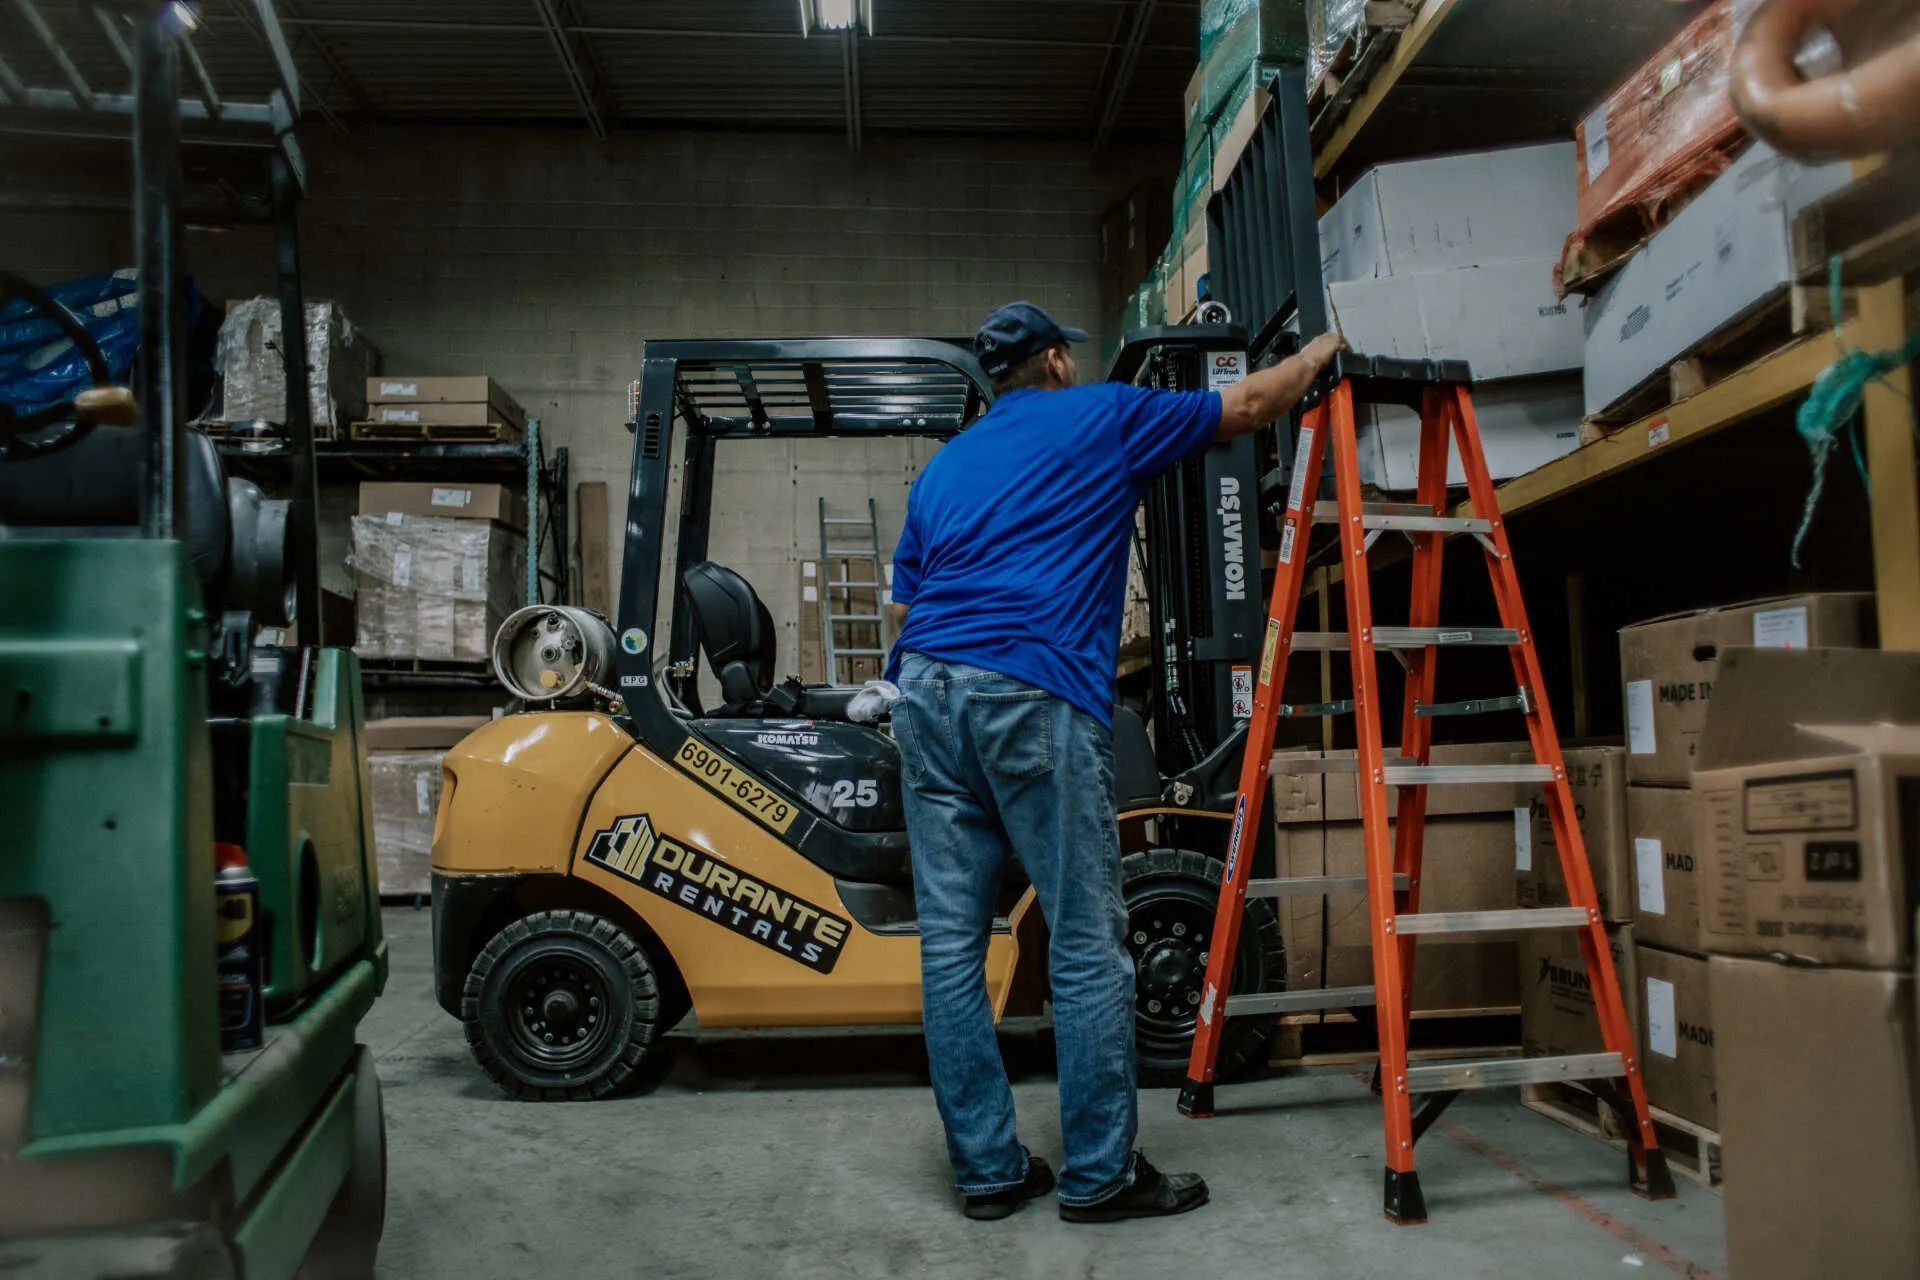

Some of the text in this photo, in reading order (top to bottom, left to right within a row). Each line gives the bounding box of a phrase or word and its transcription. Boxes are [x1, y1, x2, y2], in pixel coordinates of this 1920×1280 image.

[1216, 477, 1245, 600] KOMATSU
[623, 676, 645, 684] LPG
[1659, 682, 1696, 702] MADE
[757, 733, 818, 746] KOMATSU
[680, 742, 788, 823] 6901-6279
[832, 779, 878, 807] 25
[1666, 852, 1696, 873] MAD
[652, 840, 847, 948] DURANTE
[653, 872, 823, 963] RENTALS
[1551, 965, 1591, 990] BRUN
